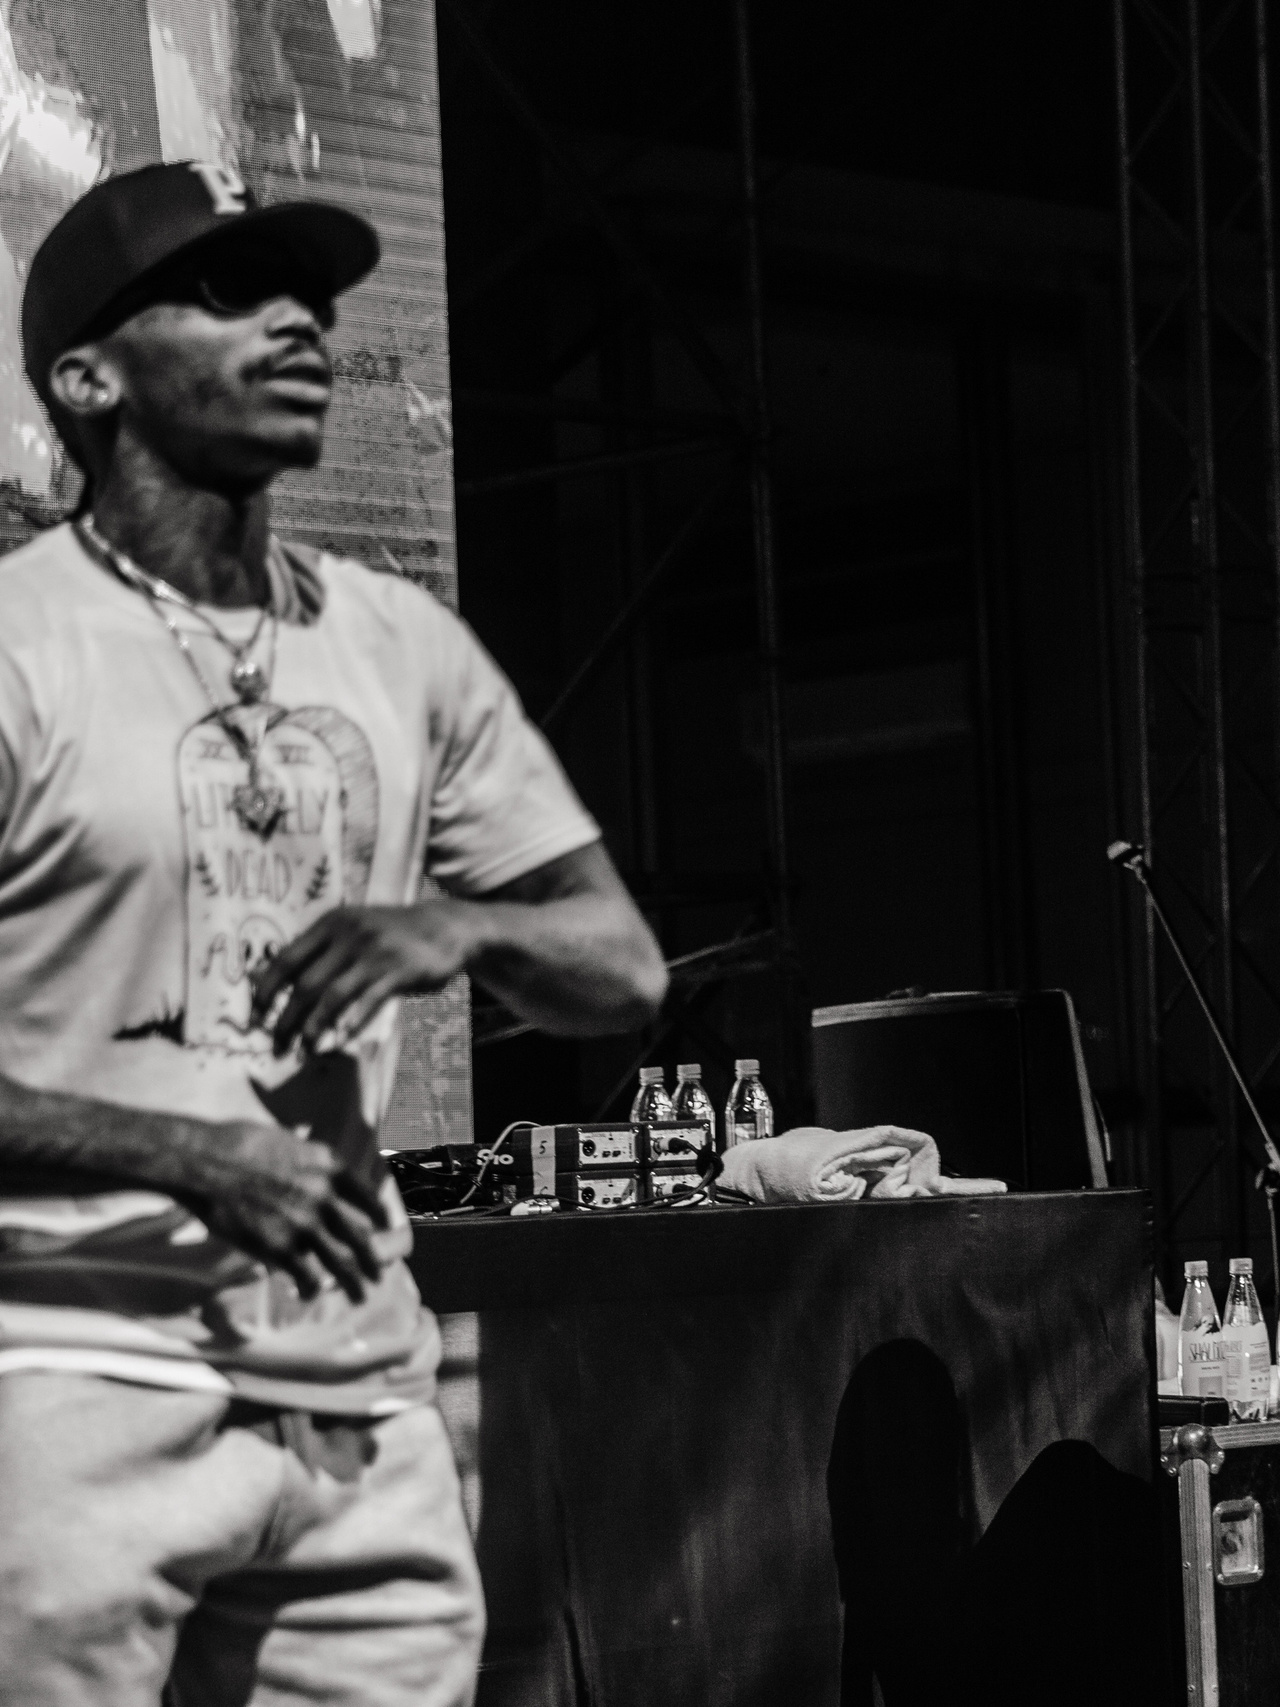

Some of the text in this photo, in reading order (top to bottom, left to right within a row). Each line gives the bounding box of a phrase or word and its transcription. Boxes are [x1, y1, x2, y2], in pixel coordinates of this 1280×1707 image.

[188, 163, 246, 214] P
[226, 849, 292, 900] DEAD
[538, 1140, 548, 1155] 5
